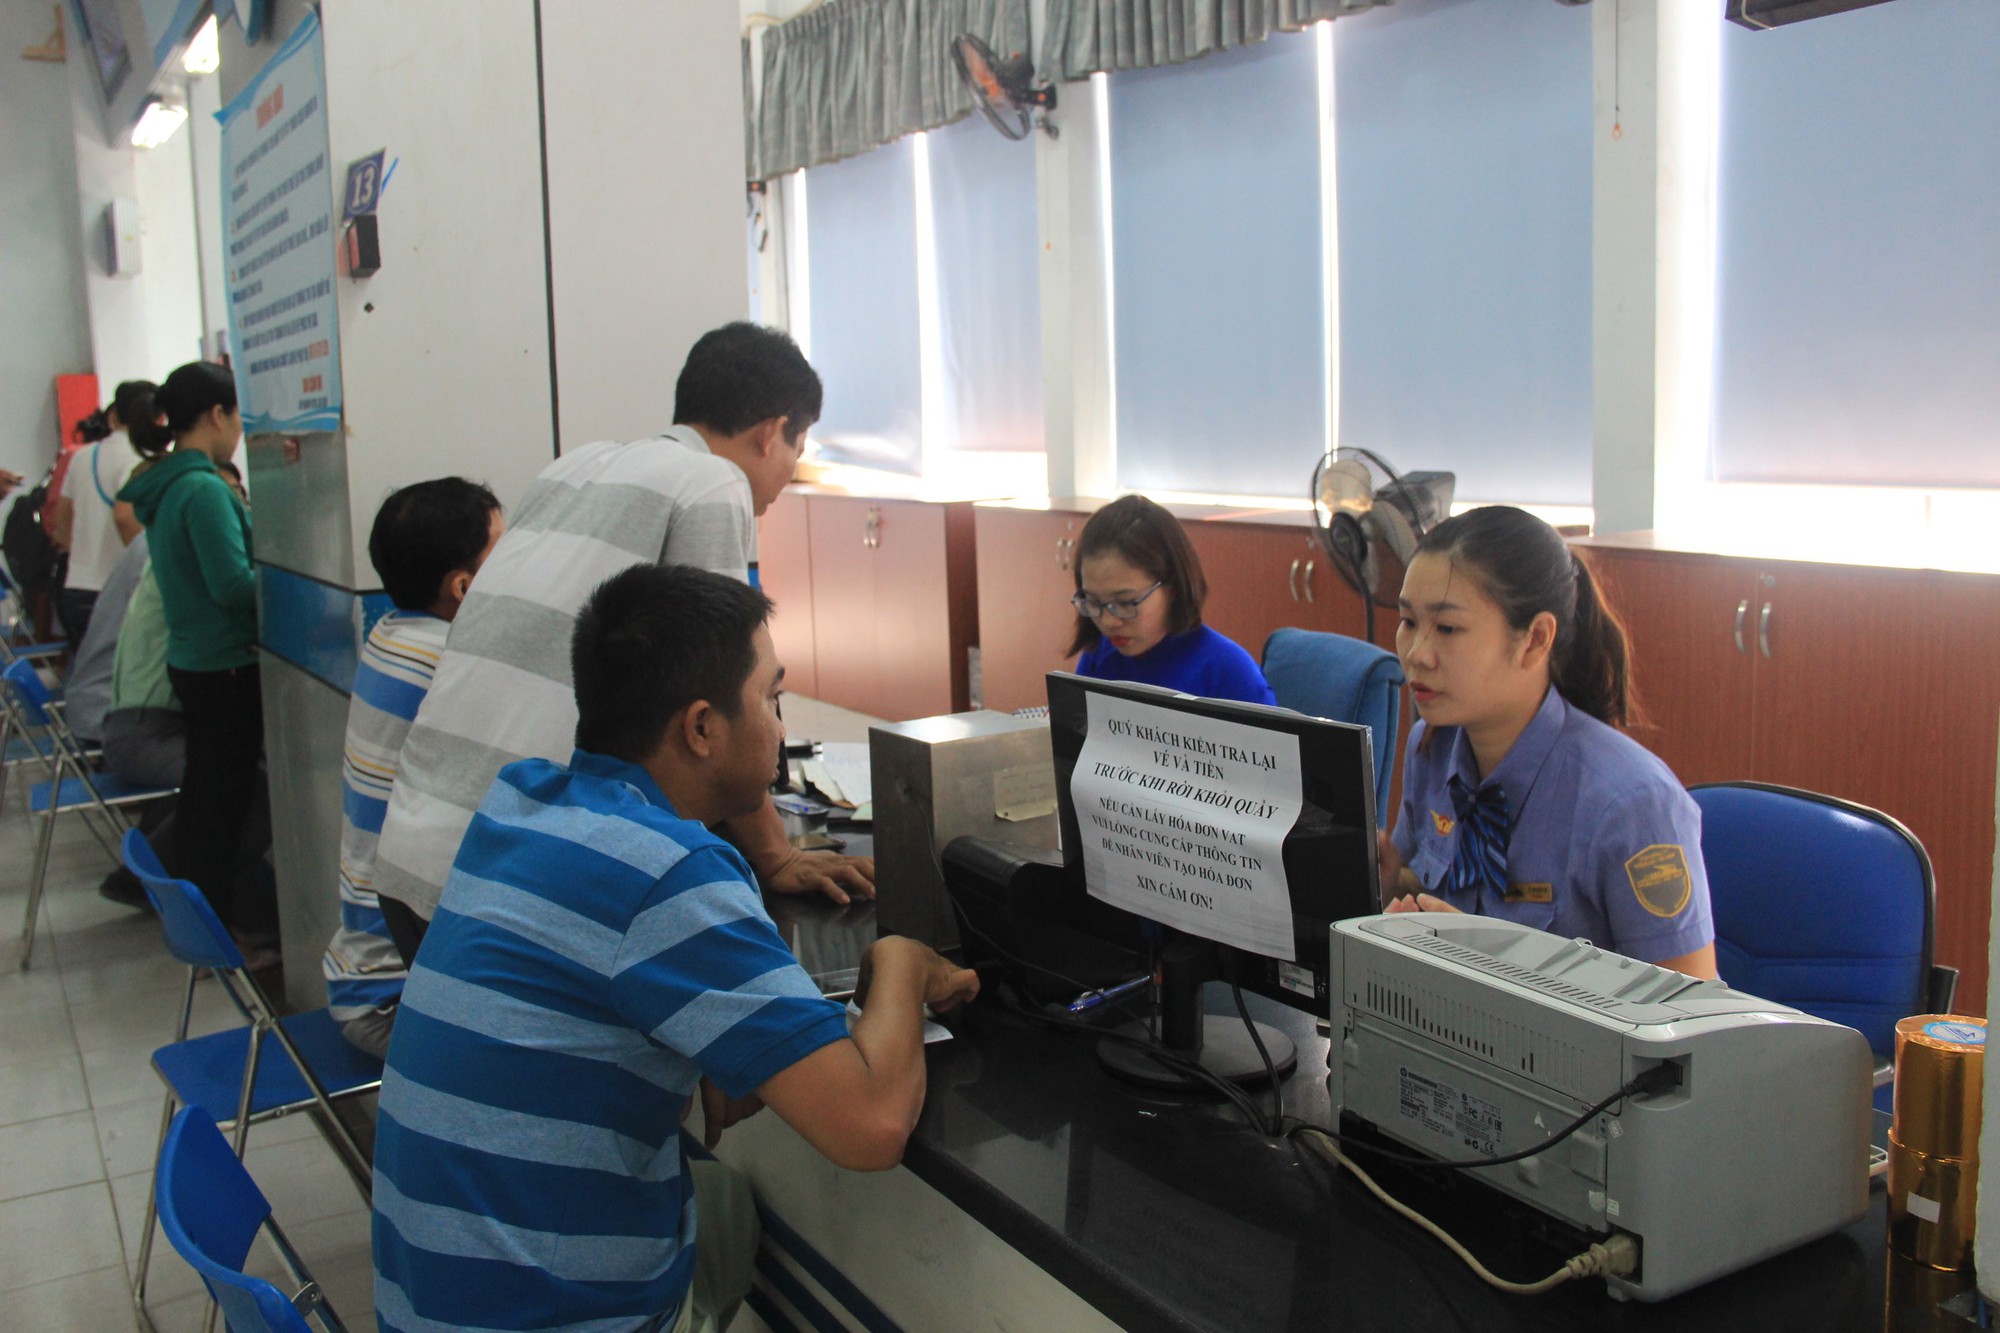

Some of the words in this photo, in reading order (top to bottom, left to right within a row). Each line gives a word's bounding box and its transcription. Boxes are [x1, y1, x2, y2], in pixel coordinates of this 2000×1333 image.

[352, 166, 375, 208] 13
[1108, 719, 1133, 736] QUÝ
[1136, 726, 1180, 748] KHÁCH
[1220, 745, 1249, 764] TRA
[1252, 752, 1277, 772] LẠI
[1173, 754, 1190, 773] VÀ
[1094, 761, 1138, 785] TRƯỚC
[1139, 772, 1167, 793] KHI
[1166, 779, 1193, 801] RỜI
[1194, 786, 1232, 809] KHỎI
[1092, 815, 1111, 830] VUI
[1109, 820, 1138, 839] LÒNG
[1140, 829, 1170, 848] CUNG
[1195, 844, 1237, 866] THÔNG
[1239, 856, 1262, 871] TIN
[1169, 815, 1192, 833] HÓA
[1195, 822, 1219, 840] ĐƠN
[1222, 829, 1246, 847] VAT
[1115, 842, 1144, 860] NHÂN
[1146, 851, 1171, 869] VIÊN
[1173, 859, 1197, 876] TẠO
[1199, 866, 1224, 884] HÓA
[1226, 874, 1252, 891] ĐƠN
[1137, 875, 1157, 892] XIN
[1190, 892, 1213, 910] ƠN!
